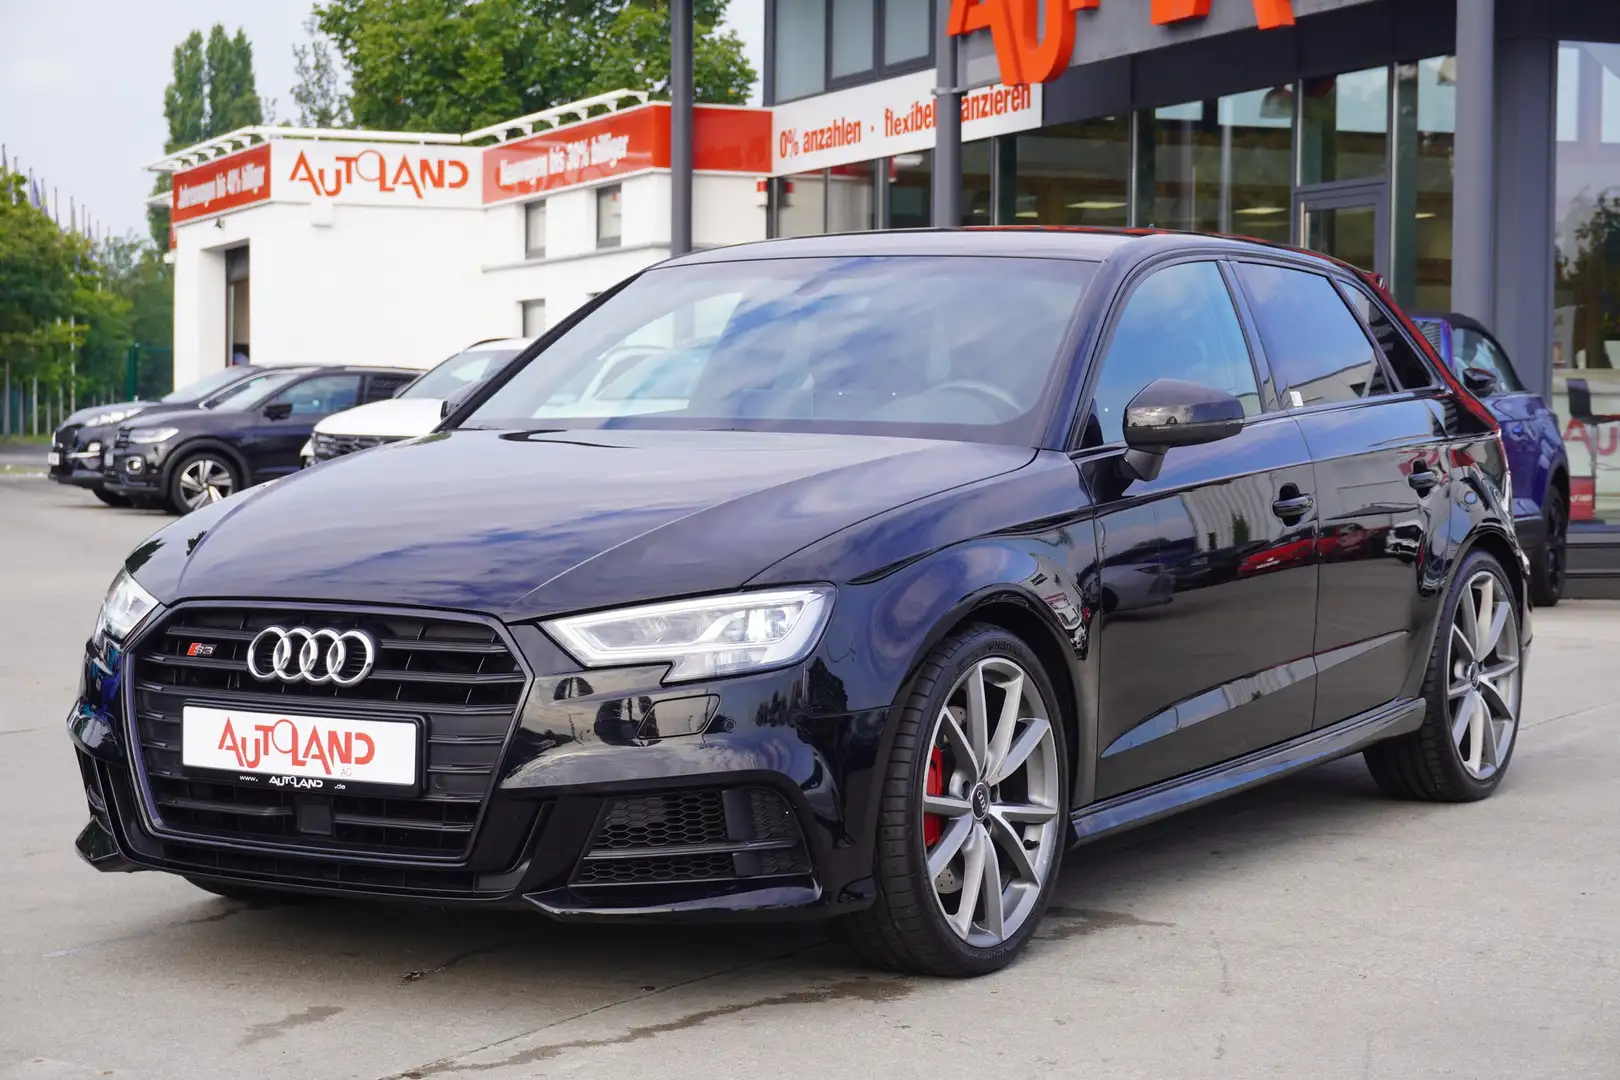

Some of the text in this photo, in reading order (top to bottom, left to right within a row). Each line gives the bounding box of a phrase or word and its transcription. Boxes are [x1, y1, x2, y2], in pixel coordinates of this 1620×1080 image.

[780, 127, 799, 158] 0%
[803, 118, 861, 153] anzahlen
[885, 98, 937, 138] flexibel
[289, 149, 469, 199] AUTOLAND
[218, 716, 375, 775] AUTOLAND
[269, 775, 324, 789] AUTOLAND
